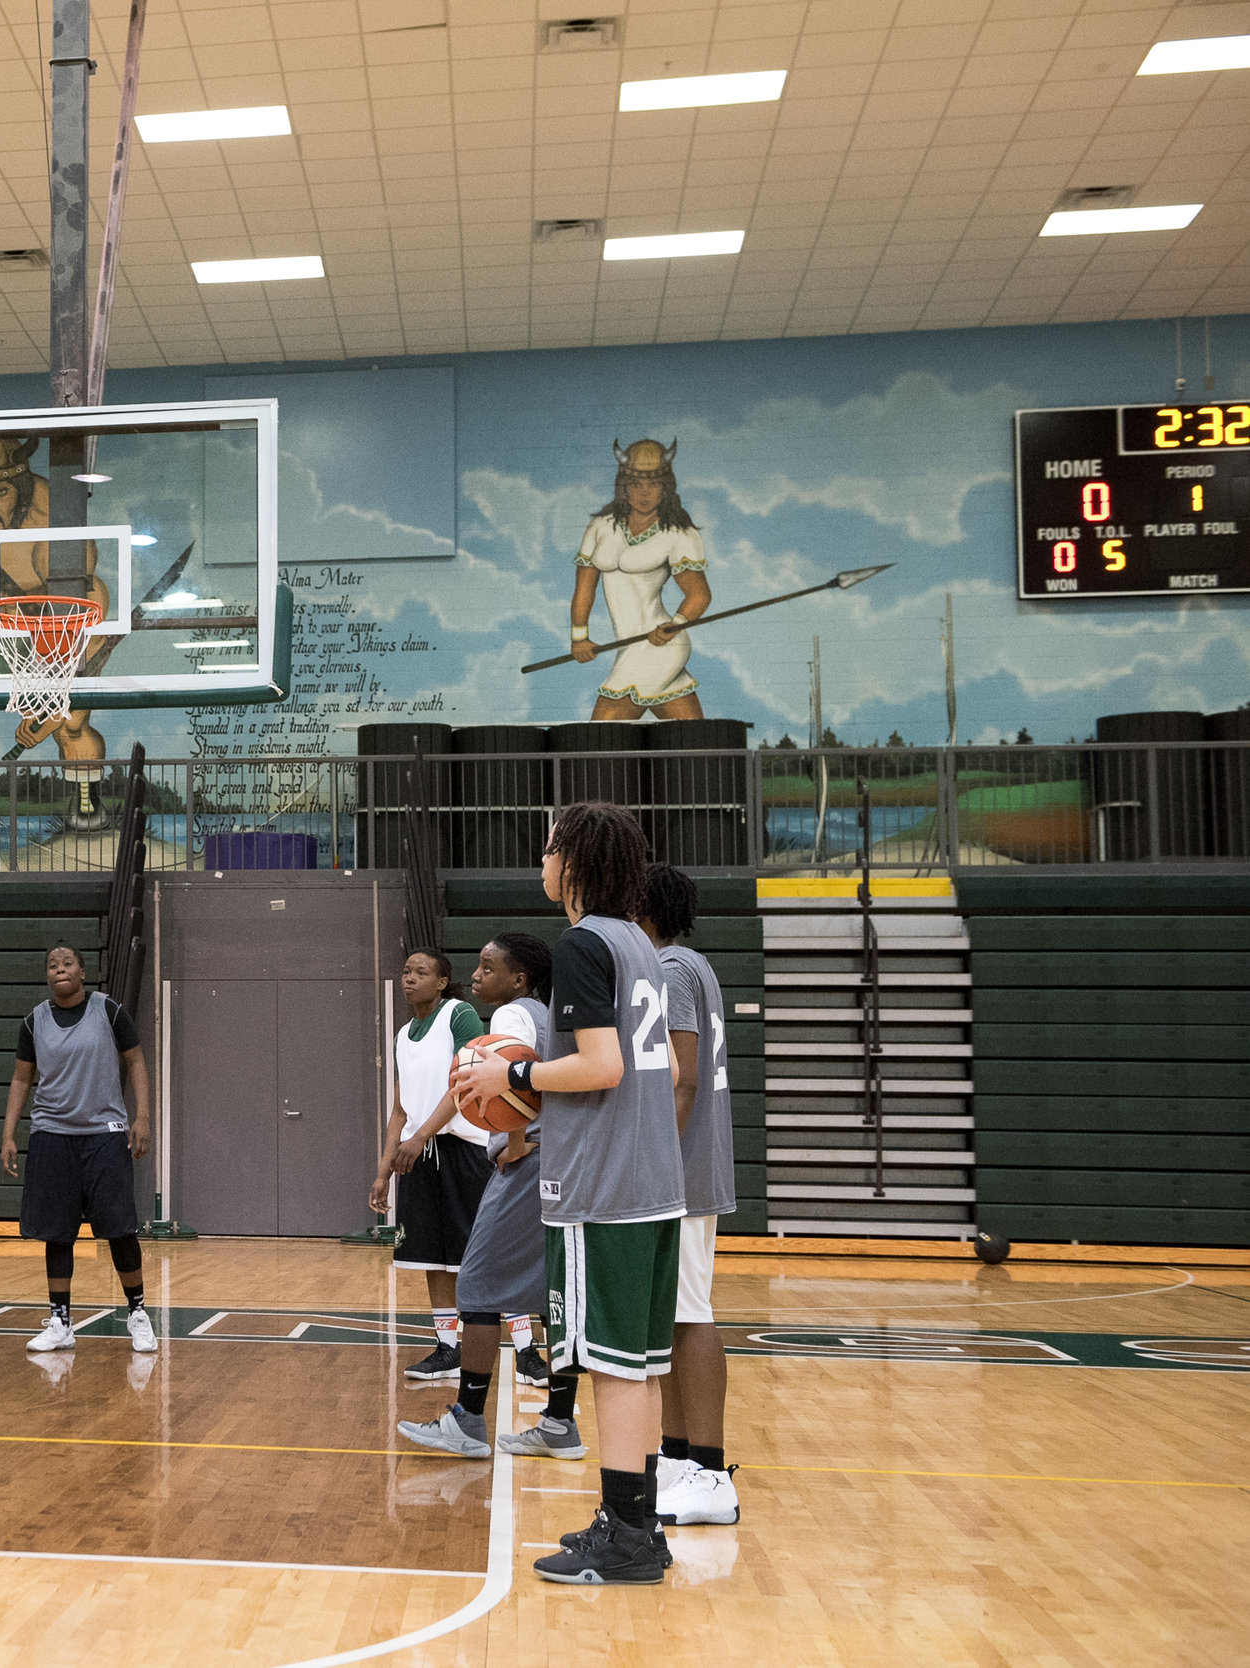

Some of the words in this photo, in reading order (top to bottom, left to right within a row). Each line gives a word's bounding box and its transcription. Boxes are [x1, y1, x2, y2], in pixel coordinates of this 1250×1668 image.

[1154, 405, 1250, 448] 2:32
[1045, 459, 1103, 478] HOME
[1165, 465, 1216, 479] PERIOD
[1081, 482, 1111, 522] 0
[1191, 484, 1204, 512] 1
[1037, 527, 1081, 541] FOULS
[1094, 526, 1132, 539] T.O.L.
[1144, 523, 1197, 538] PLAYER
[1203, 521, 1239, 535] FOUL
[1053, 541, 1077, 573] 0
[1102, 539, 1126, 571] 5
[279, 567, 311, 587] Alma
[315, 567, 364, 590] Mater
[1045, 579, 1078, 592] WON
[1169, 574, 1218, 588] MATCH
[308, 618, 317, 634] to
[317, 624, 343, 637] your
[291, 638, 318, 657] ritage
[318, 644, 345, 658] your
[347, 632, 397, 656] Vikings
[294, 664, 316, 678] you
[295, 683, 321, 694] name
[324, 683, 339, 694] we
[345, 673, 367, 693] will
[273, 693, 318, 717] challenge
[319, 703, 340, 717] you
[345, 696, 362, 713] set
[365, 690, 385, 712] for
[388, 702, 408, 712] our
[187, 715, 230, 735] Founded
[233, 719, 244, 735] in
[249, 724, 257, 734] a
[257, 717, 286, 738] great
[190, 735, 229, 758] Strong
[232, 739, 243, 754] in
[216, 783, 246, 799] green
[252, 776, 272, 794] and
